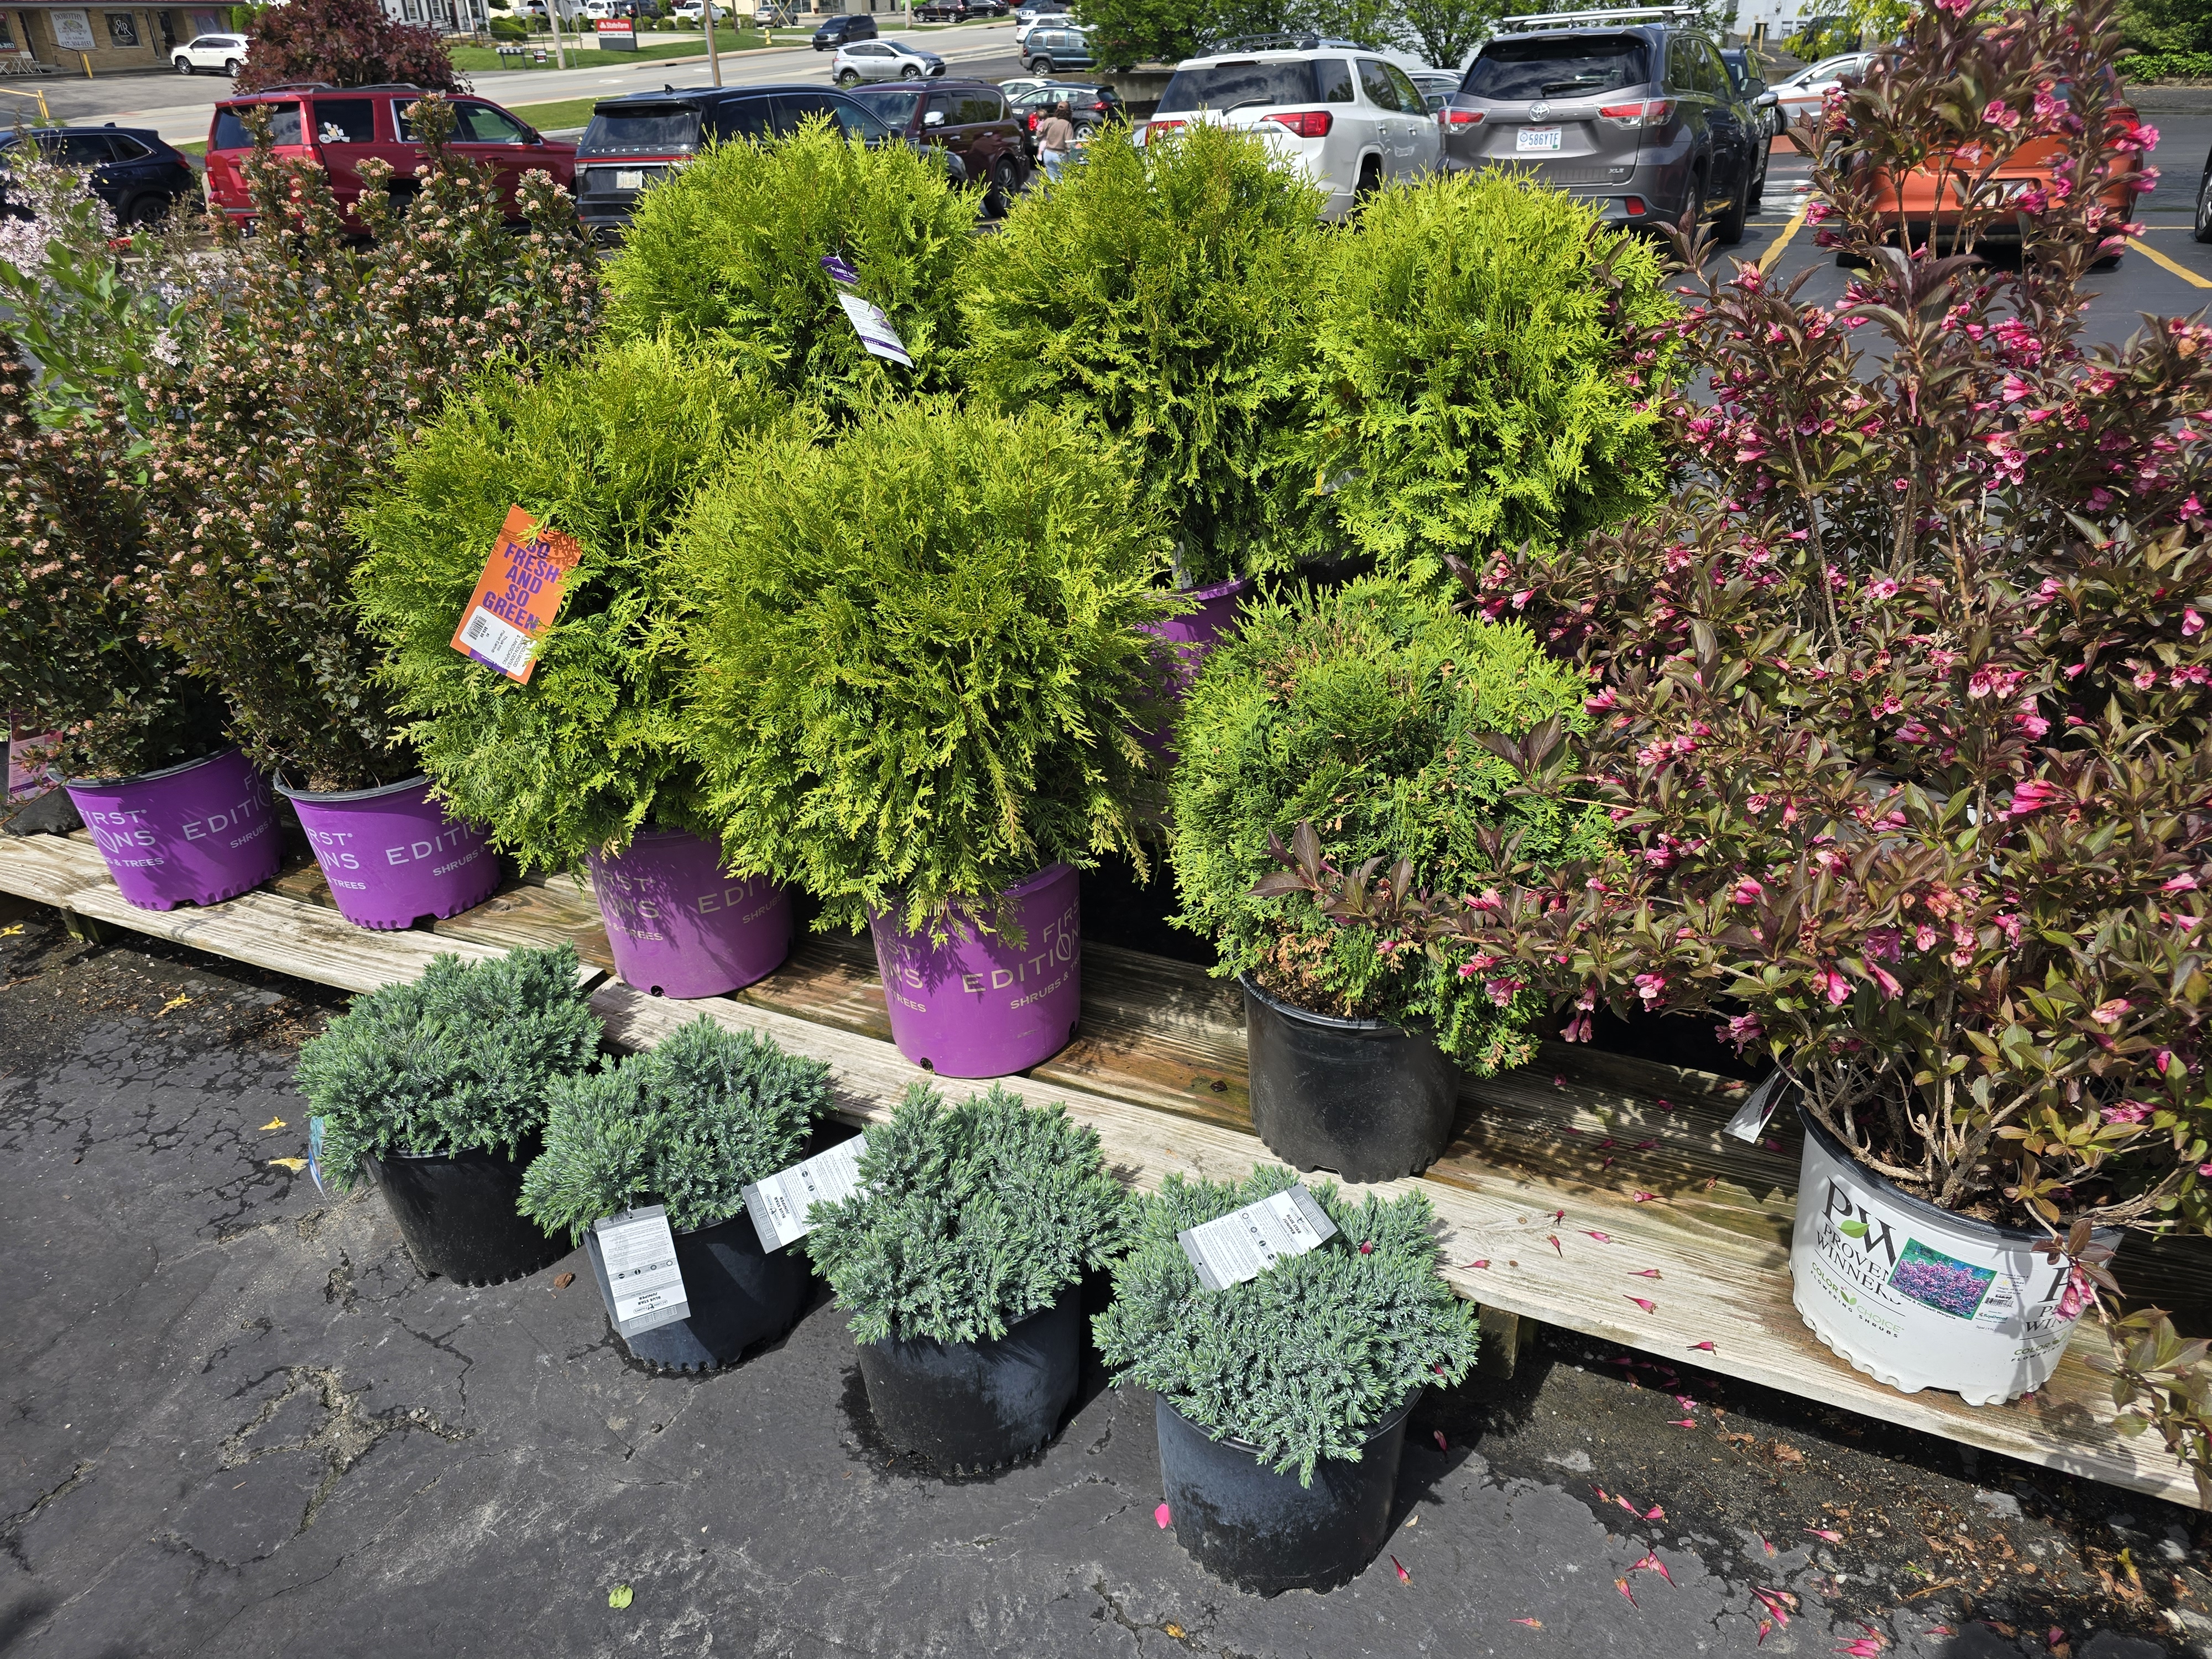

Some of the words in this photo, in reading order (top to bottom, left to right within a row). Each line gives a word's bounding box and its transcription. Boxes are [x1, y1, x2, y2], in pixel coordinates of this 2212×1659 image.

[1528, 133, 1559, 145] 586YTF
[504, 542, 560, 583] FRESH
[505, 565, 543, 594] AND
[505, 583, 530, 608] SO
[482, 591, 540, 631] GREEN
[230, 821, 269, 848] SHRUBS
[122, 858, 165, 867] TREES
[432, 849, 478, 876] SHRUBS
[331, 877, 366, 890] TREES
[742, 892, 782, 924] SHRUBS
[621, 926, 663, 941] TREES
[891, 988, 926, 1013] TREES
[1010, 978, 1061, 1009] SHRUBS
[780, 1196, 790, 1214] JUNIPER
[1282, 1218, 1296, 1235] JUNIPER
[1812, 1262, 1838, 1293] COLOR
[639, 1292, 658, 1300] JUNIPER
[1810, 1270, 1853, 1313] FLOWERING
[1858, 1314, 1898, 1338] SHRUBS
[1900, 1293, 1912, 1301] Wine
[1937, 1310, 1956, 1320] Weigela
[2014, 1342, 2051, 1355] COLOR
